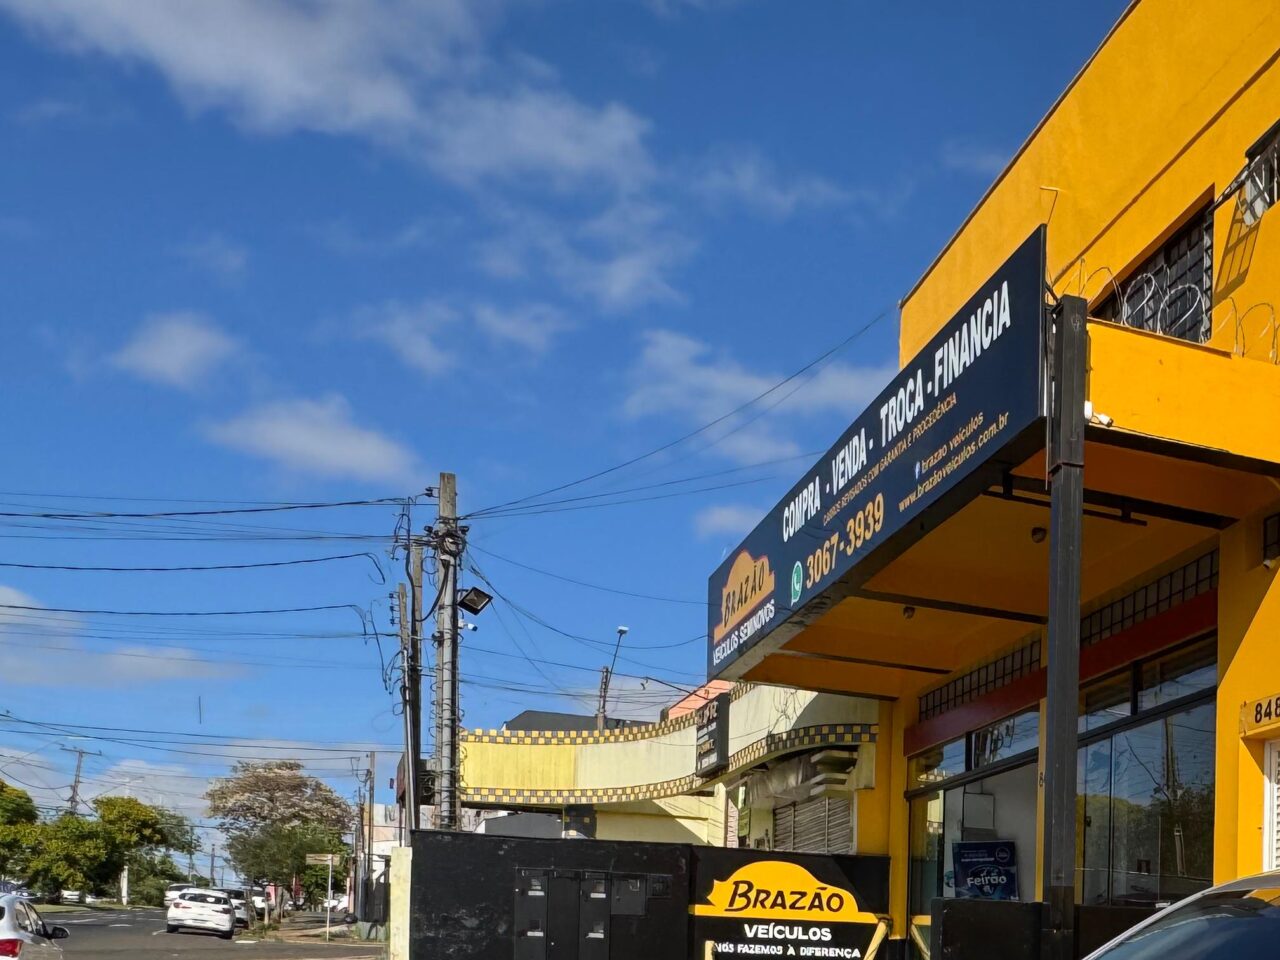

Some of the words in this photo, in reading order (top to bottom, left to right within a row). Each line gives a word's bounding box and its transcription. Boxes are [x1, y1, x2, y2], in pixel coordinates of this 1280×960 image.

[783, 476, 820, 542] COMPRA
[832, 427, 867, 495] VENDA
[880, 368, 924, 447] TROCA
[935, 280, 1011, 397] FINANCIA
[880, 438, 907, 471] GARANTIA
[806, 492, 884, 589] 3067-3939
[723, 557, 765, 628] BRAZÃO
[739, 598, 775, 644] SEMINOVOS
[714, 942, 734, 953] NÓS
[738, 943, 782, 955] FAZEMOS
[800, 946, 861, 959] DIFERENÇA
[744, 922, 832, 941] VEÍCULOS
